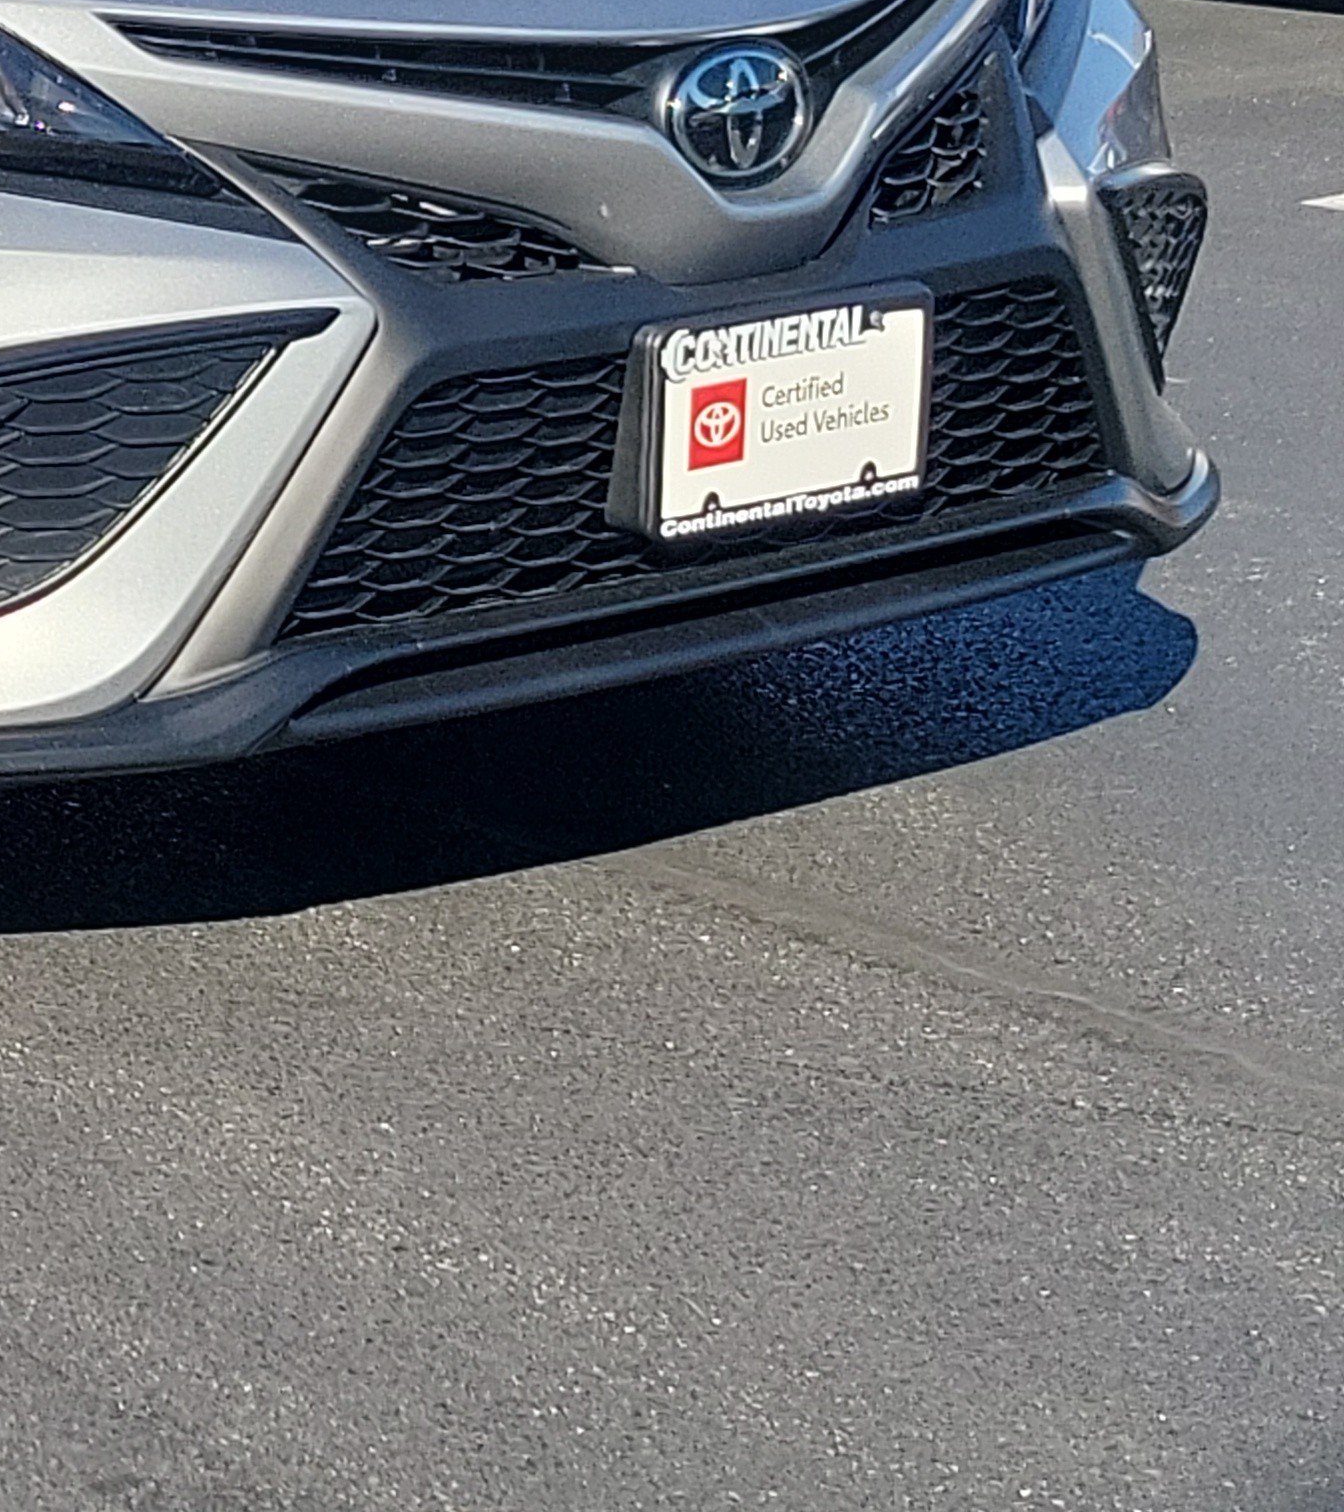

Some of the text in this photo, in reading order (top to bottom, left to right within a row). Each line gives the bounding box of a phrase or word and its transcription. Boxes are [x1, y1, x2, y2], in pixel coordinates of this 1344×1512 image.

[661, 305, 864, 382] CONTINENTAL
[761, 371, 845, 408] Certified
[760, 402, 890, 443] Used Vehicles
[659, 474, 920, 538] ContinentalToyota.com
